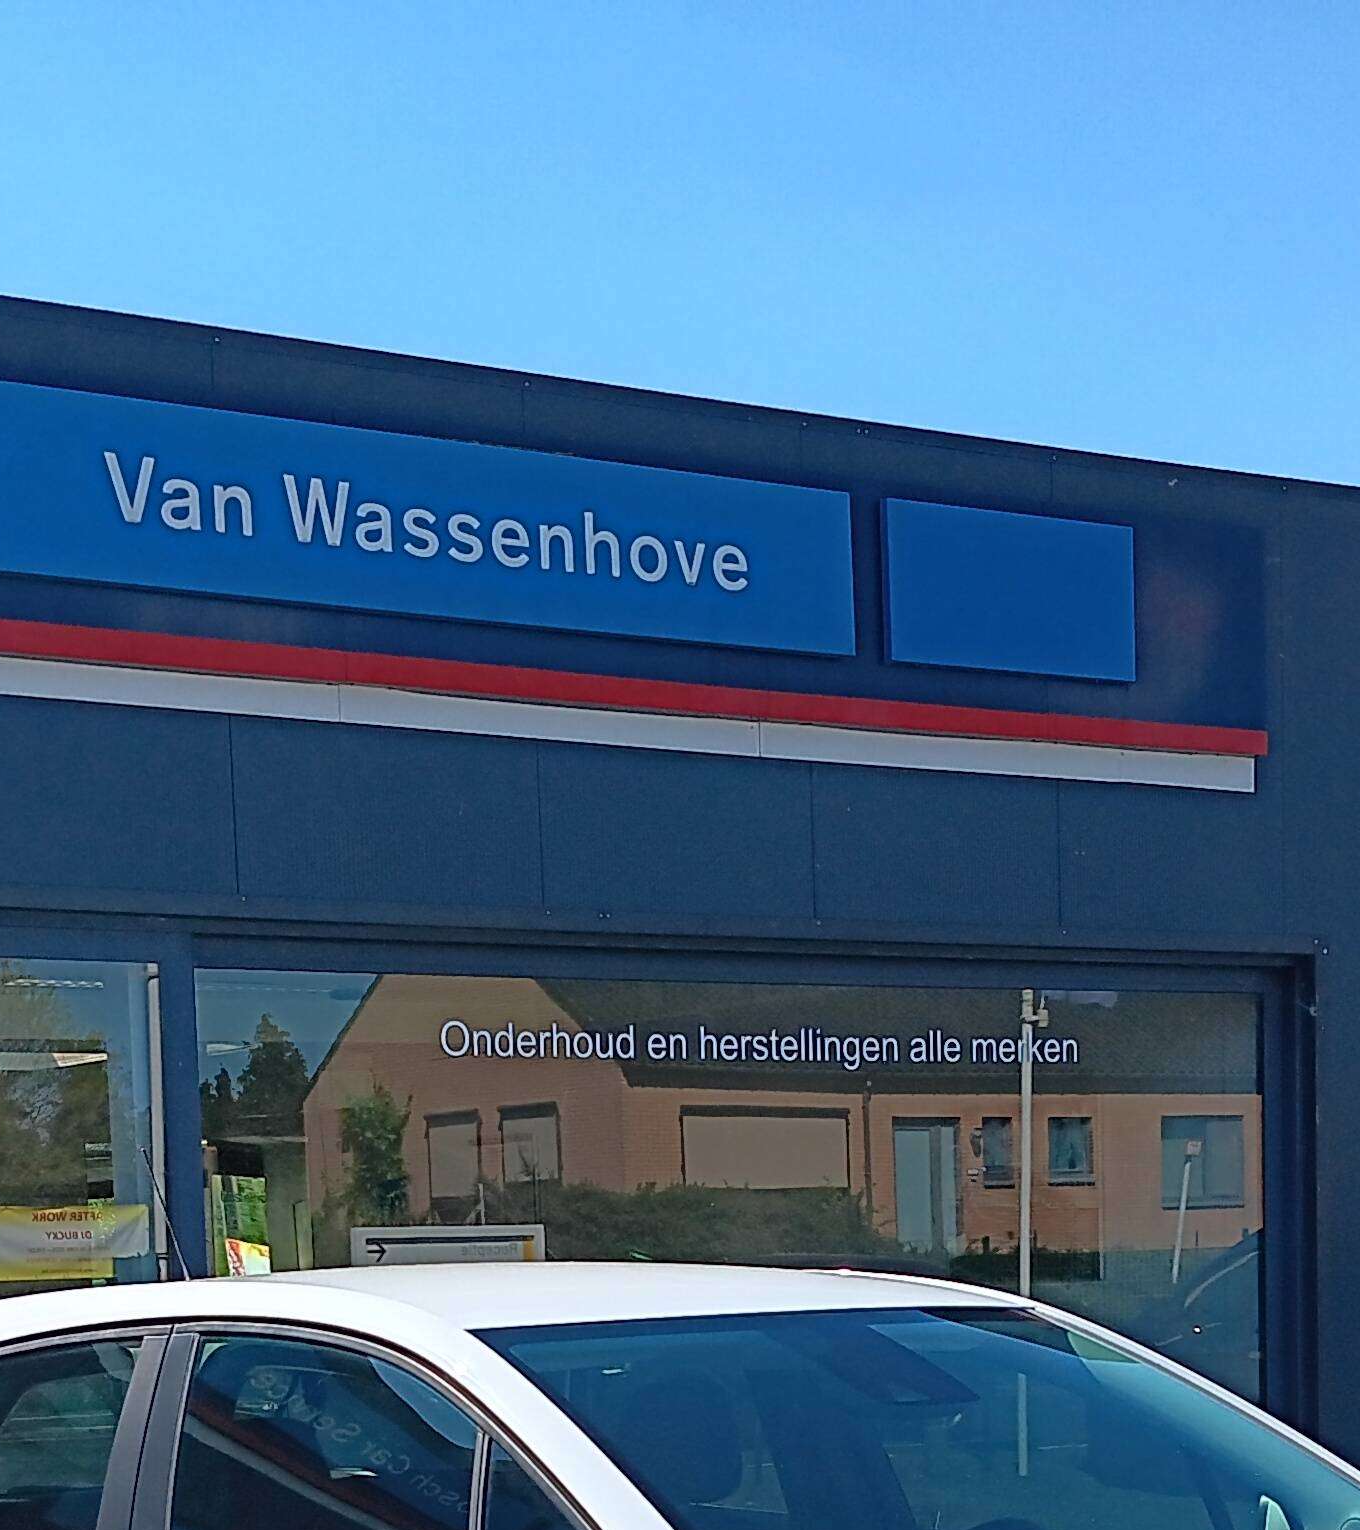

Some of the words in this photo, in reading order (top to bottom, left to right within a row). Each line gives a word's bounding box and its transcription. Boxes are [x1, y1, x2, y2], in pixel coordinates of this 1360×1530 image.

[103, 451, 253, 537] Van
[283, 474, 750, 591] Wassenhove
[439, 1020, 636, 1061] Onderhoud
[647, 1031, 688, 1060] en
[698, 1025, 899, 1071] herstellingen
[909, 1028, 962, 1064] alle
[970, 1030, 1080, 1065] merken
